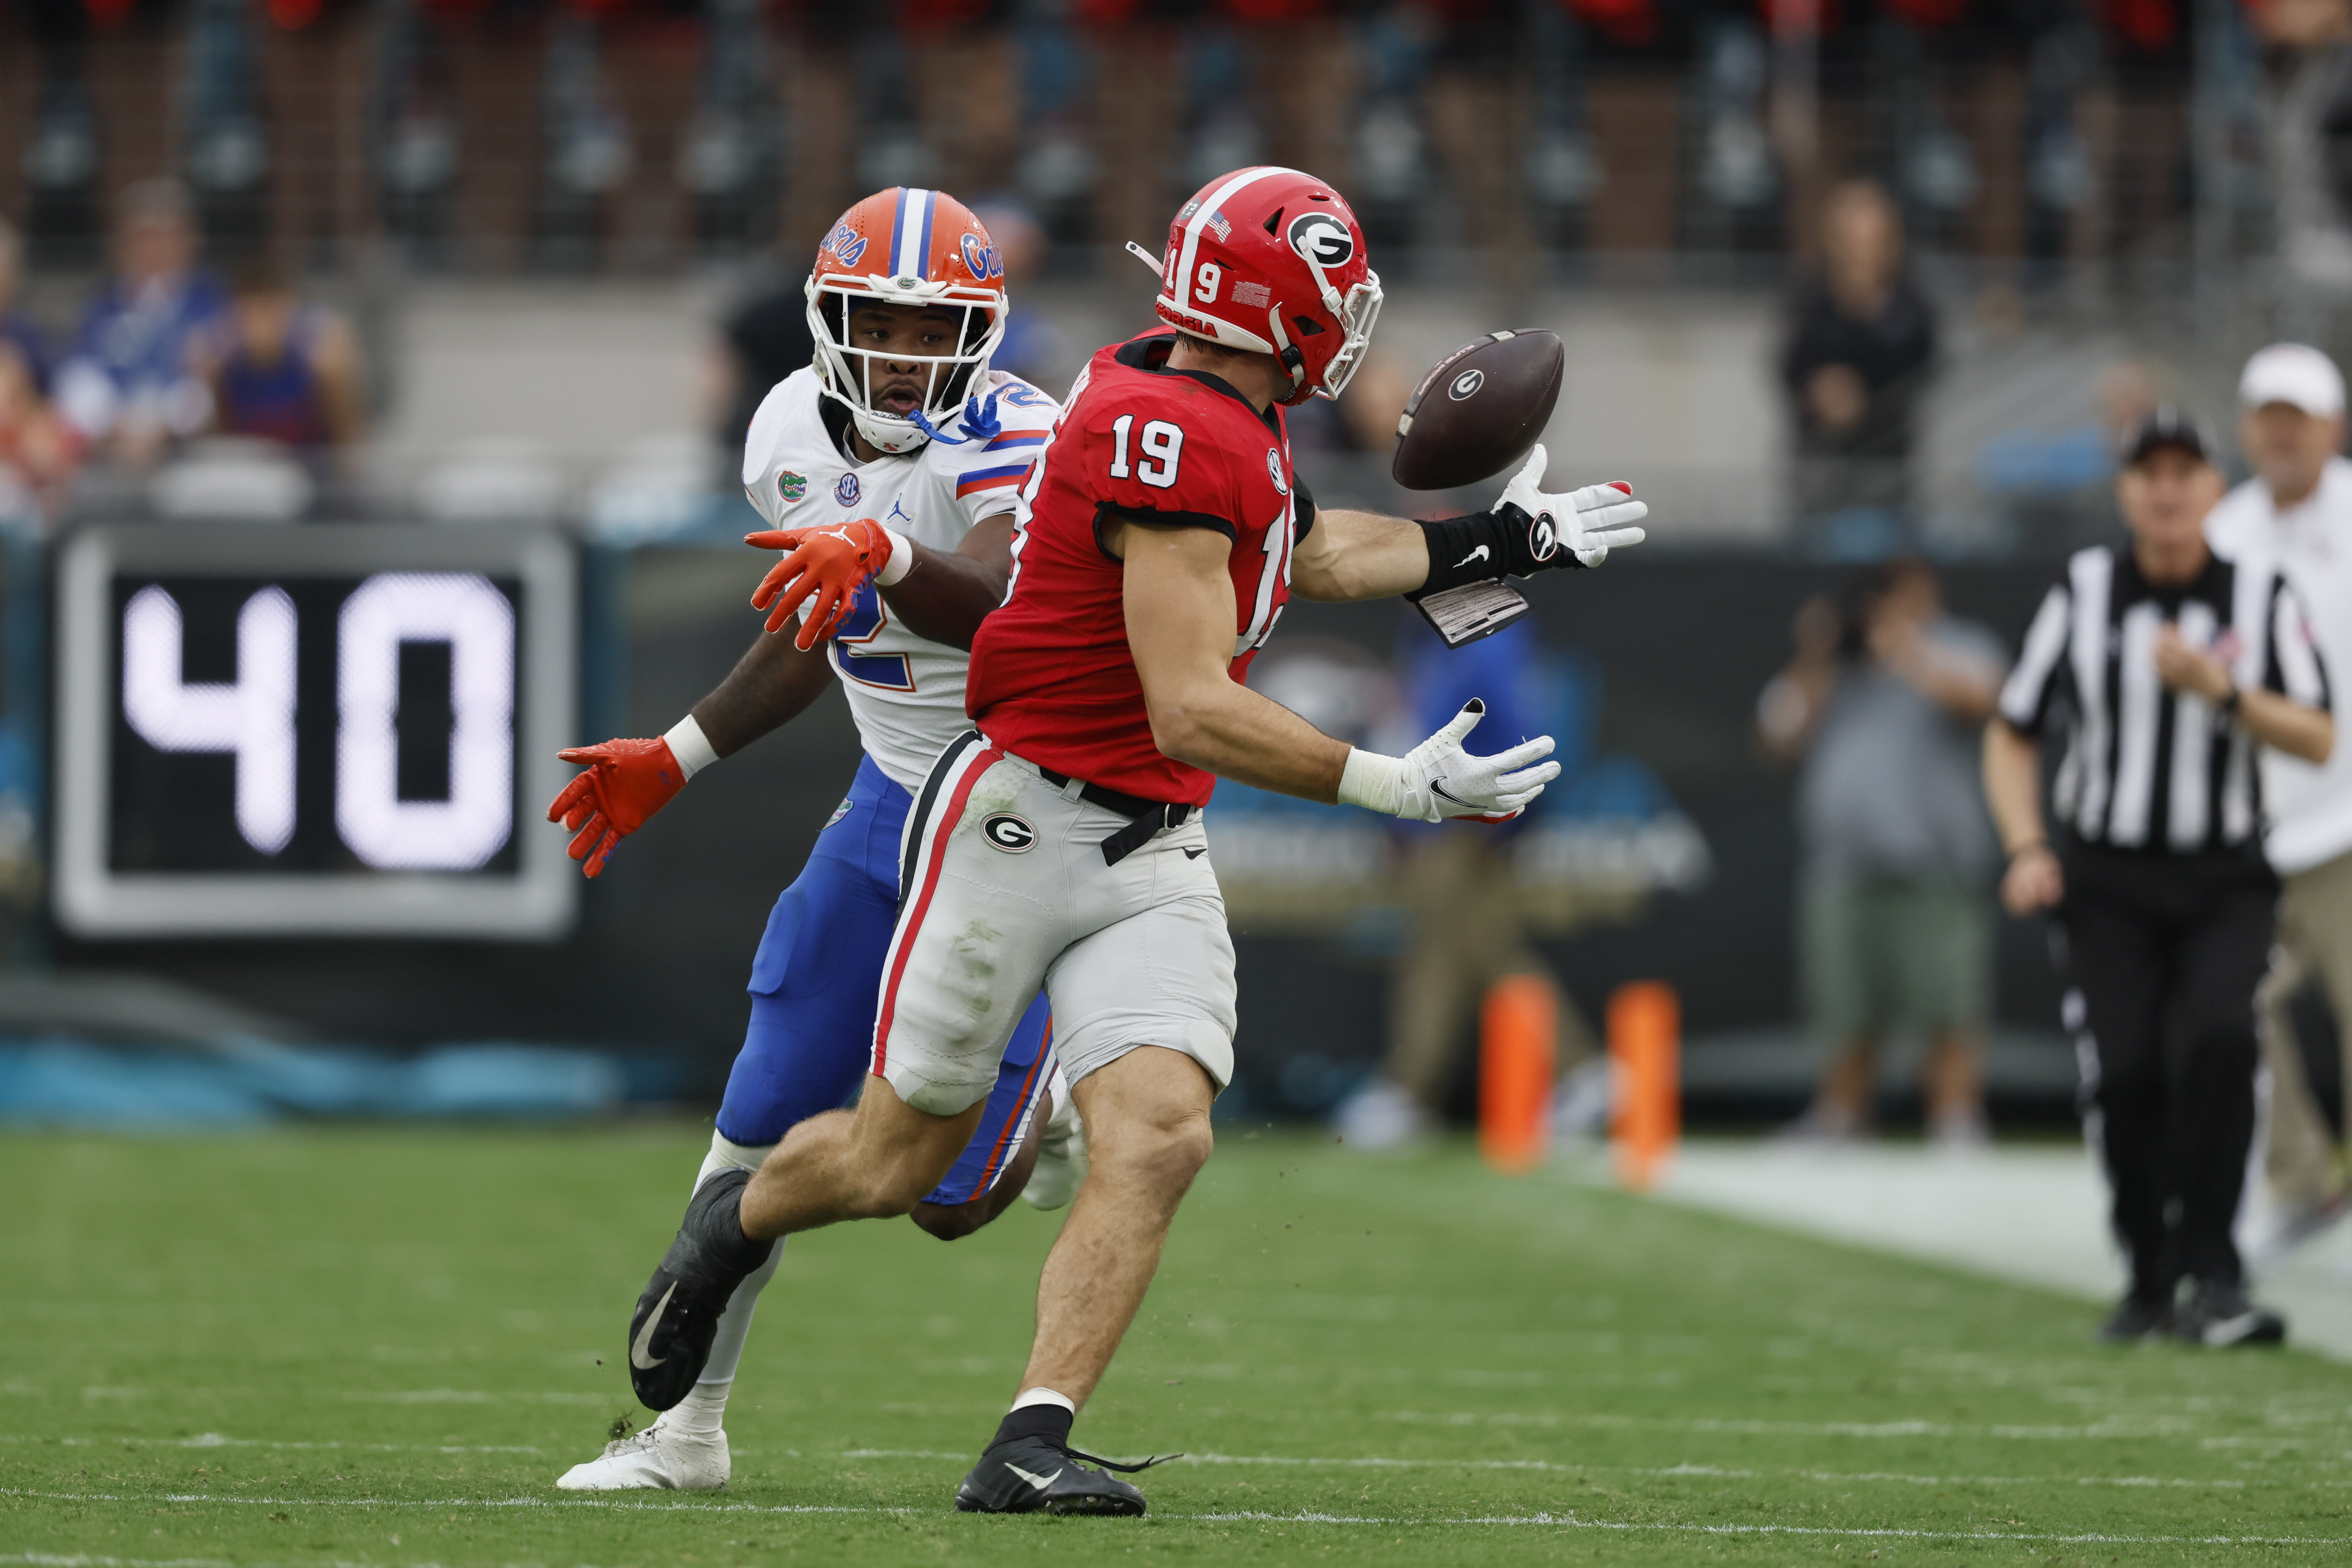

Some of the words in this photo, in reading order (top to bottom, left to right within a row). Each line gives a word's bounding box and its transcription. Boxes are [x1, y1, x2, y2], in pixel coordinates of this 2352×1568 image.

[1109, 413, 1185, 490] 19
[836, 492, 856, 506] GRADUATE
[841, 474, 857, 498] SEC
[123, 571, 515, 871] 40
